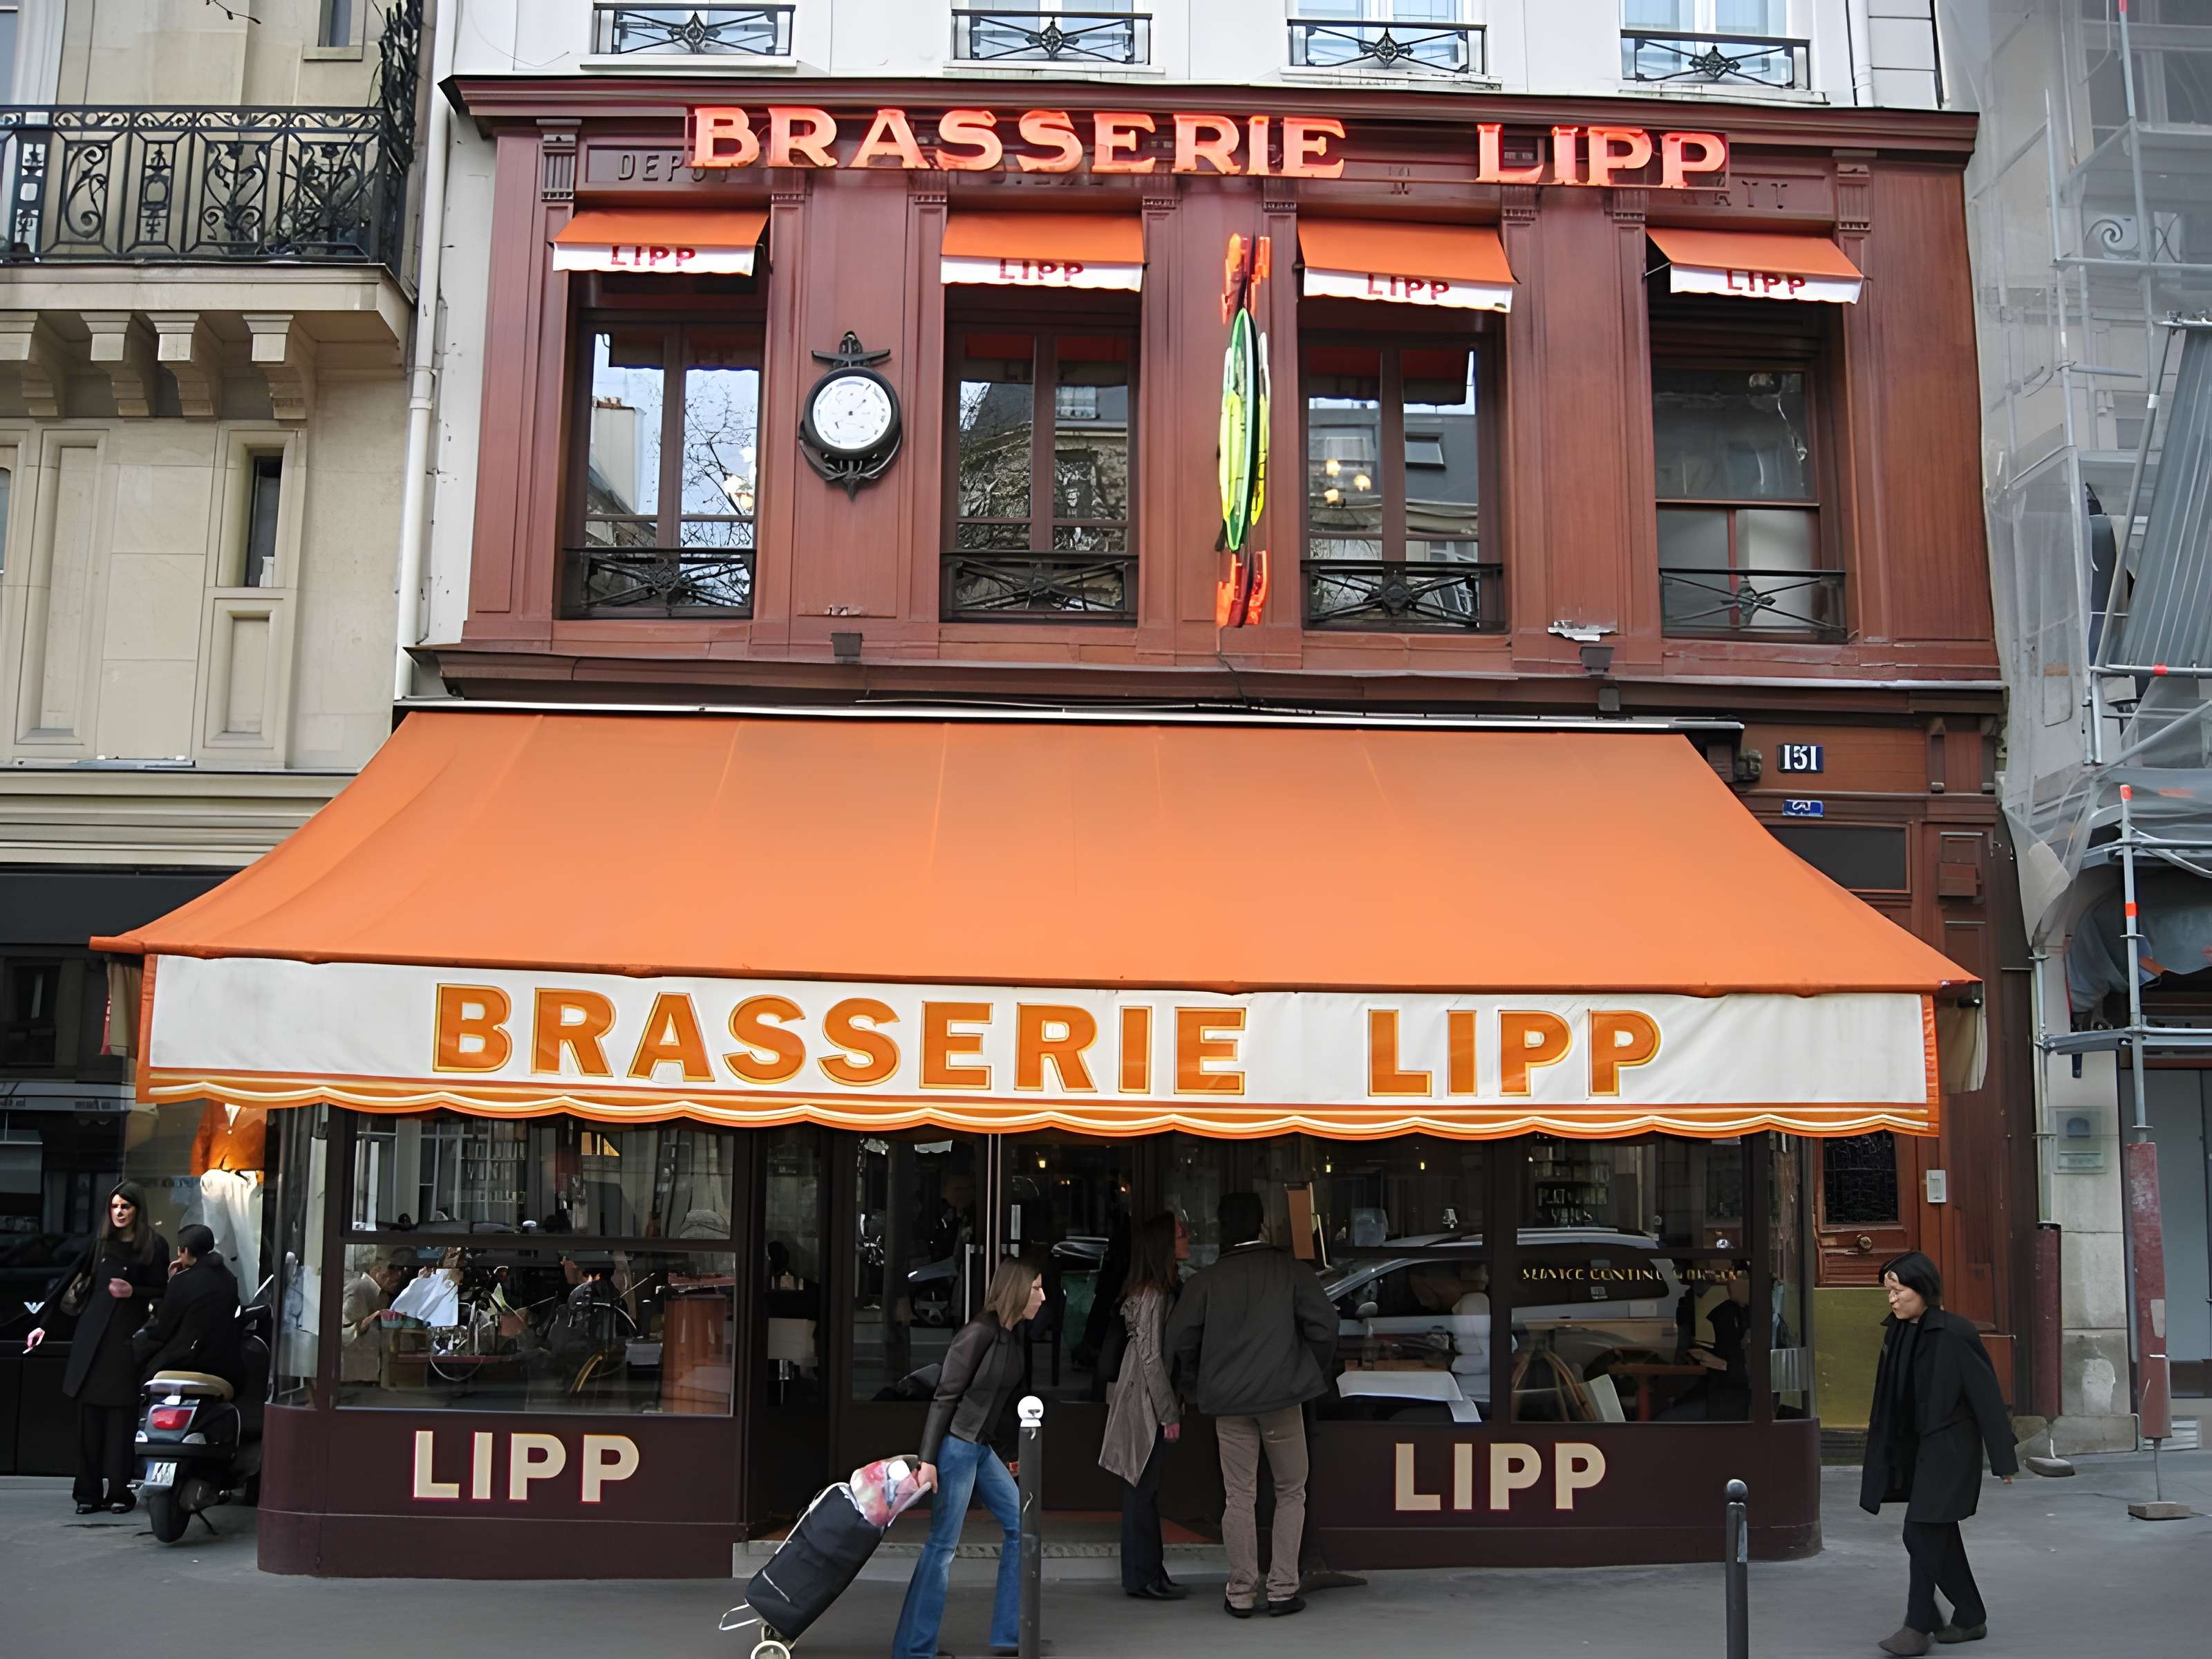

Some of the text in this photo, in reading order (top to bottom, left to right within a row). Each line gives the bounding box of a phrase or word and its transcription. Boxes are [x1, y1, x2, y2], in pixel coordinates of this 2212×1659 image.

[692, 106, 1345, 179] BRASSERIE
[1475, 122, 1726, 189] LIPP
[611, 245, 696, 267] LIPP
[1000, 258, 1085, 281] LIPP
[1368, 274, 1450, 300] LIPP
[1727, 269, 1806, 295] LIPP
[433, 982, 1664, 1098] BRASSERIE LIPP
[413, 1430, 640, 1503] LIPP
[1395, 1442, 1606, 1510] LIPP
